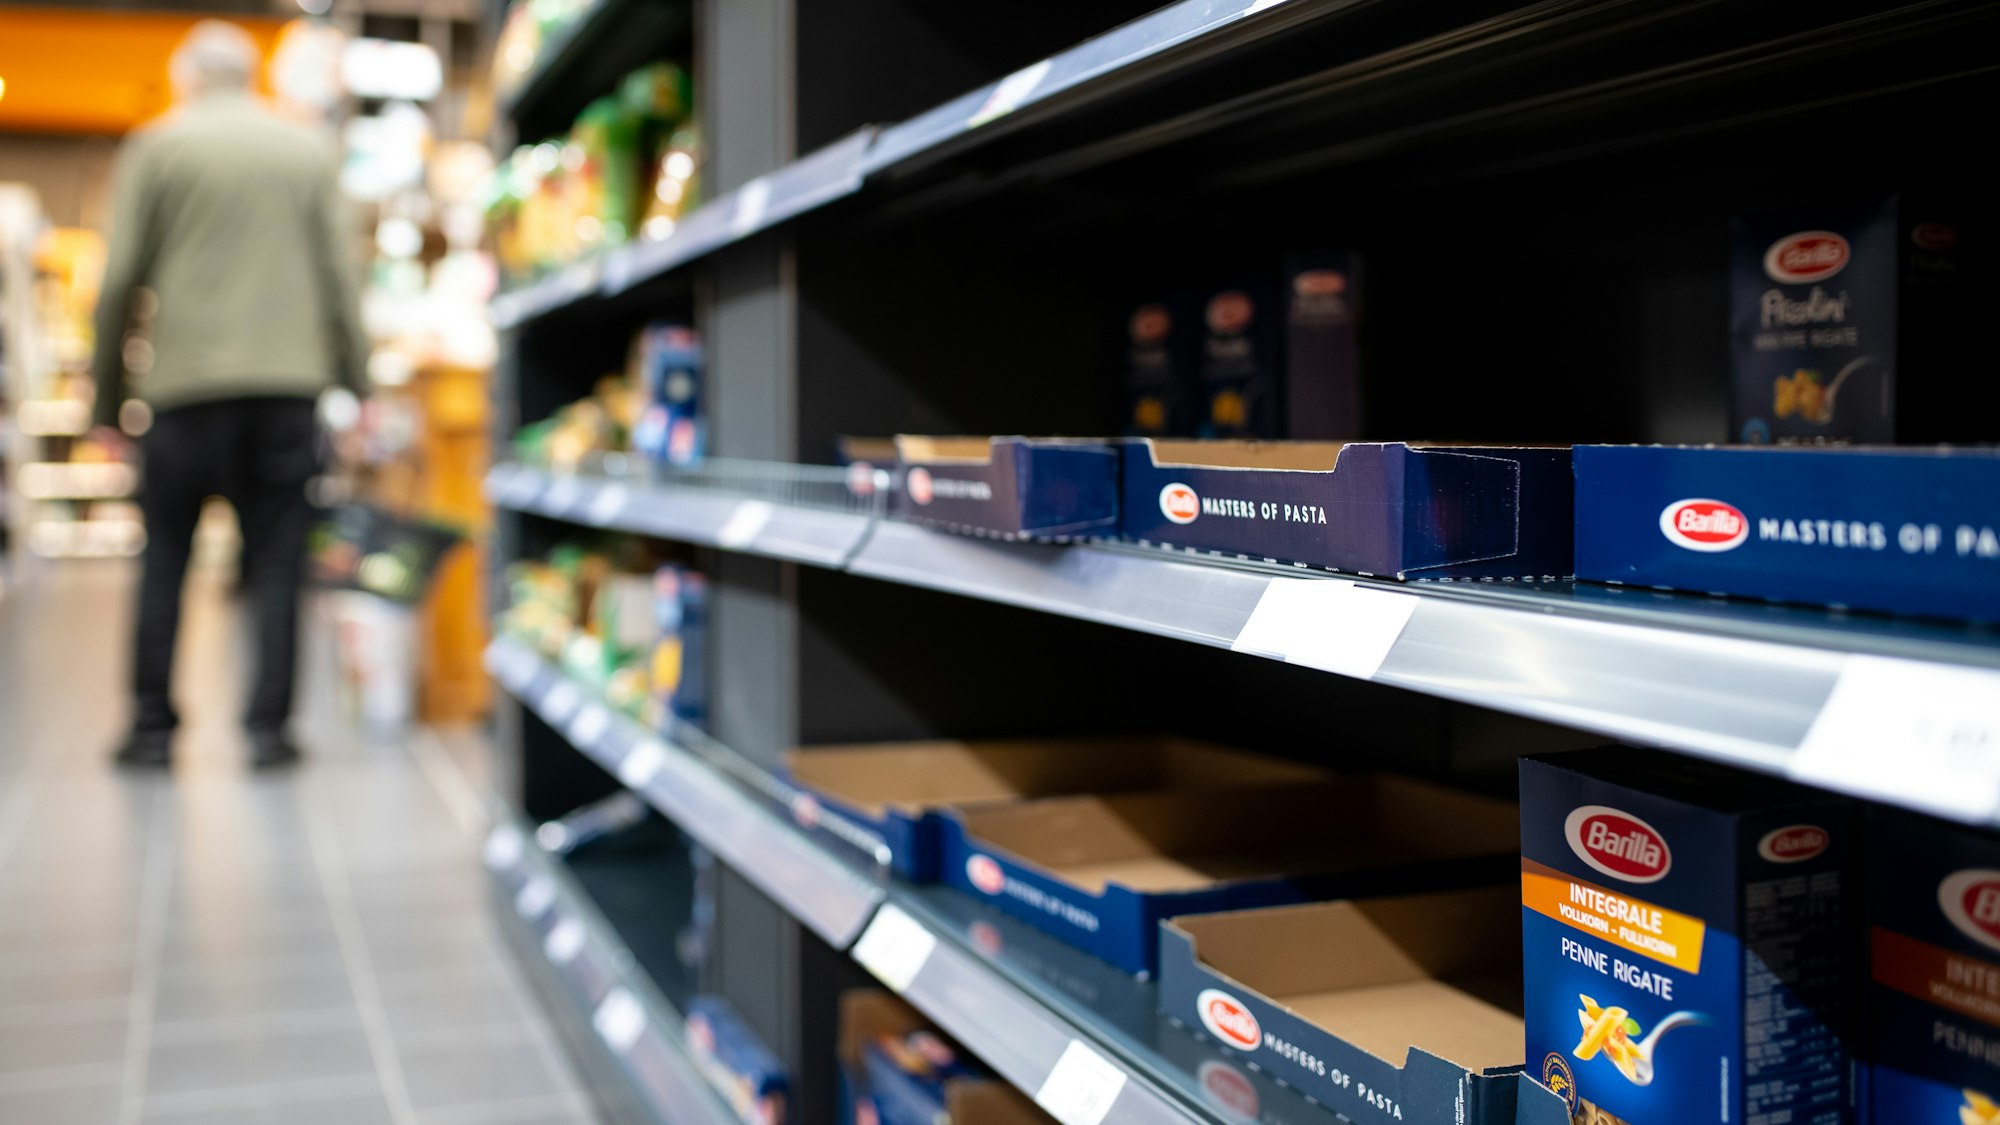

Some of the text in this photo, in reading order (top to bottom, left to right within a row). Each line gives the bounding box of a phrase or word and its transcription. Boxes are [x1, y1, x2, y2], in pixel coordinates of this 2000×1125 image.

[1202, 497, 1256, 518] MASTERS
[1261, 502, 1278, 520] OF
[1284, 504, 1327, 525] PASTA
[1677, 508, 1741, 536] Barilla
[1758, 517, 1888, 551] MASTERS
[1897, 522, 1943, 555] OF
[1587, 820, 1662, 869] Barilla
[1558, 902, 1609, 934] VOLLKORN
[1569, 882, 1663, 935] INTEGRALE
[1561, 936, 1673, 1001] PENNE RIGATE
[1263, 1032, 1326, 1077] MASTERS
[1330, 1068, 1350, 1089] OF
[1357, 1082, 1403, 1121] PASTA
